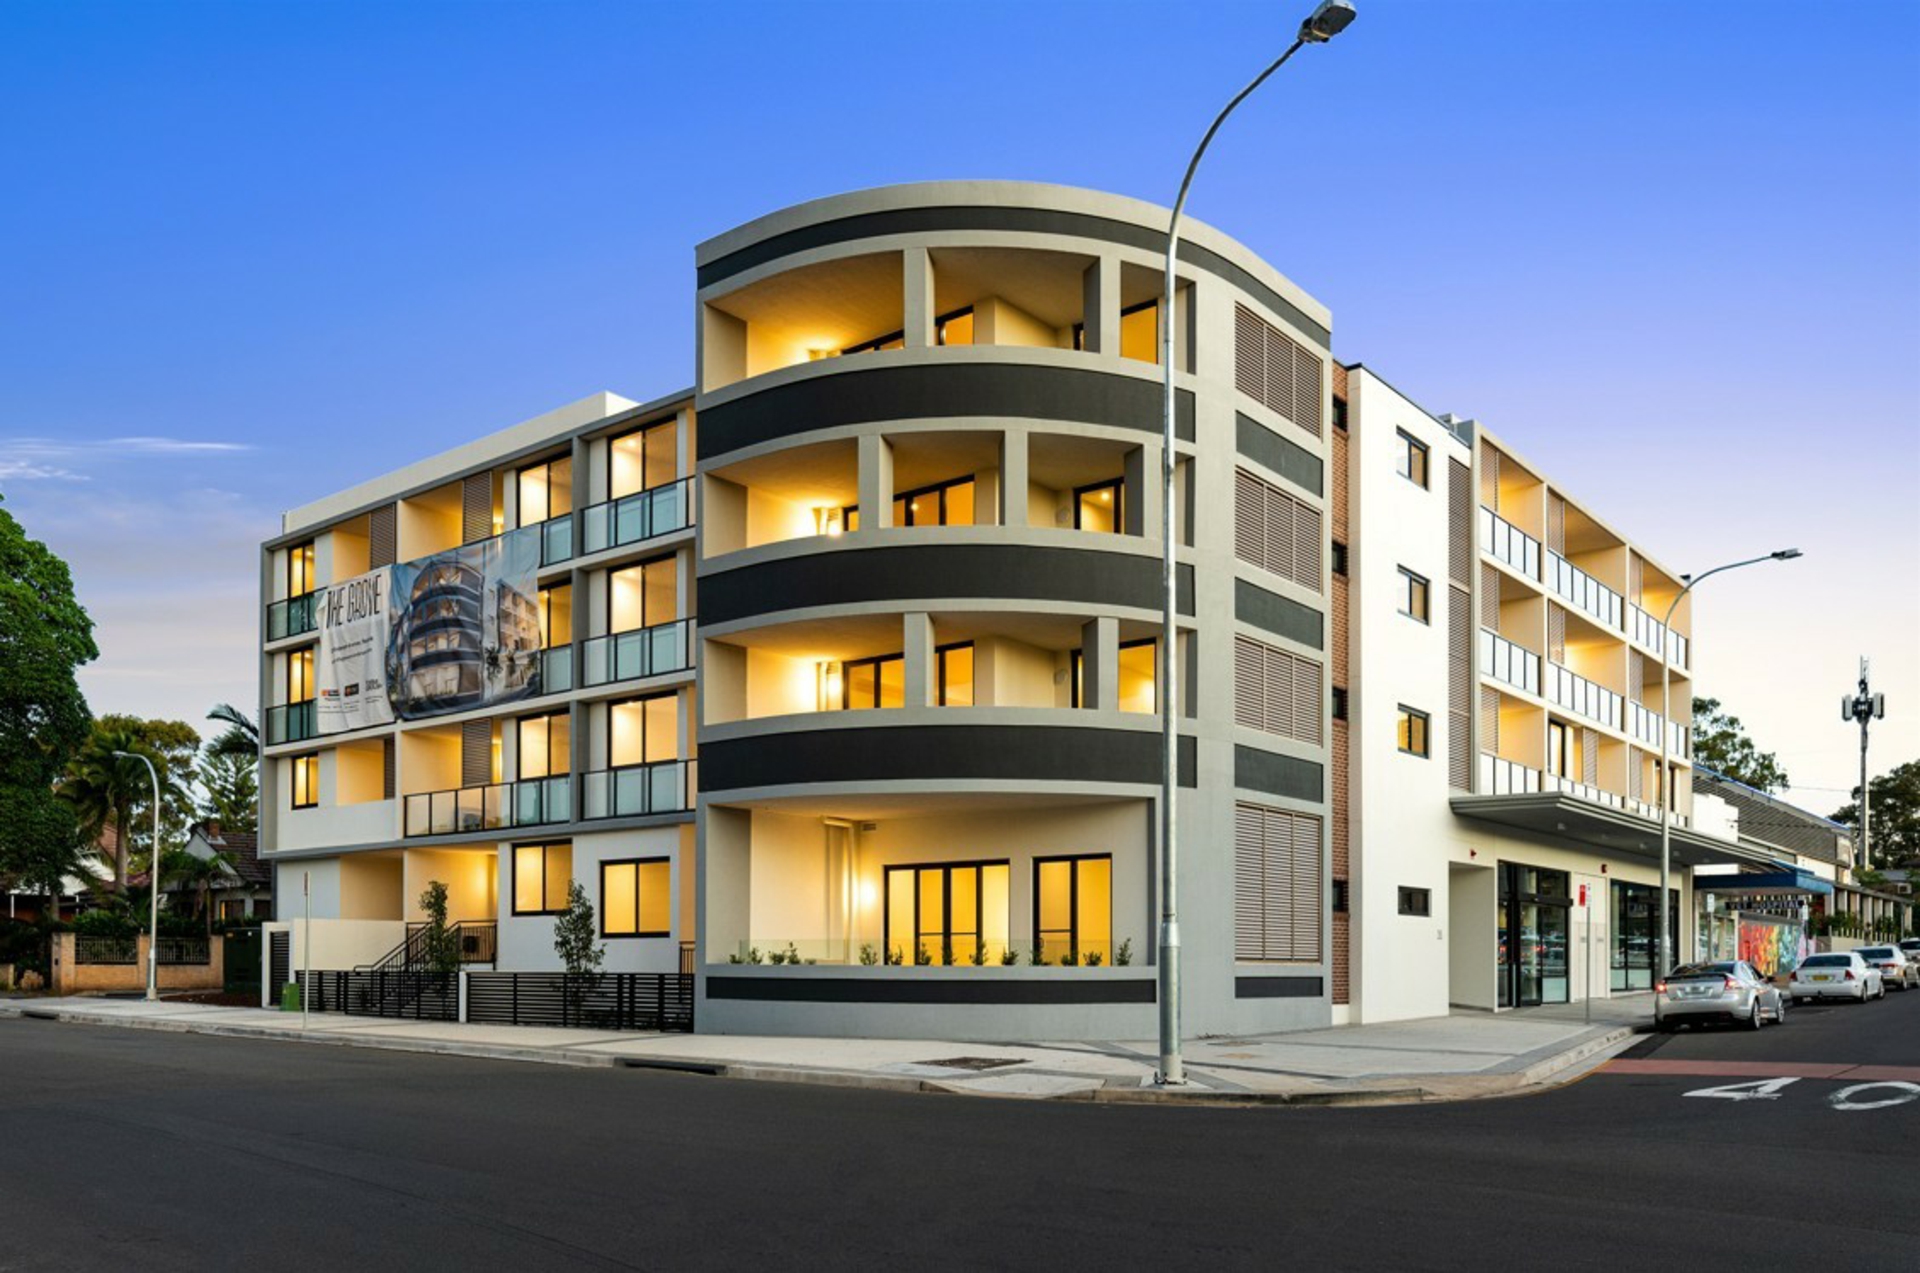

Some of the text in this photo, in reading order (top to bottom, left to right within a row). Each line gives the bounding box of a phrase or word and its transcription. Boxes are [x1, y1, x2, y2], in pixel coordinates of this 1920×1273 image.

[326, 573, 382, 629] THE GROVE
[1681, 1077, 1920, 1110] 40
